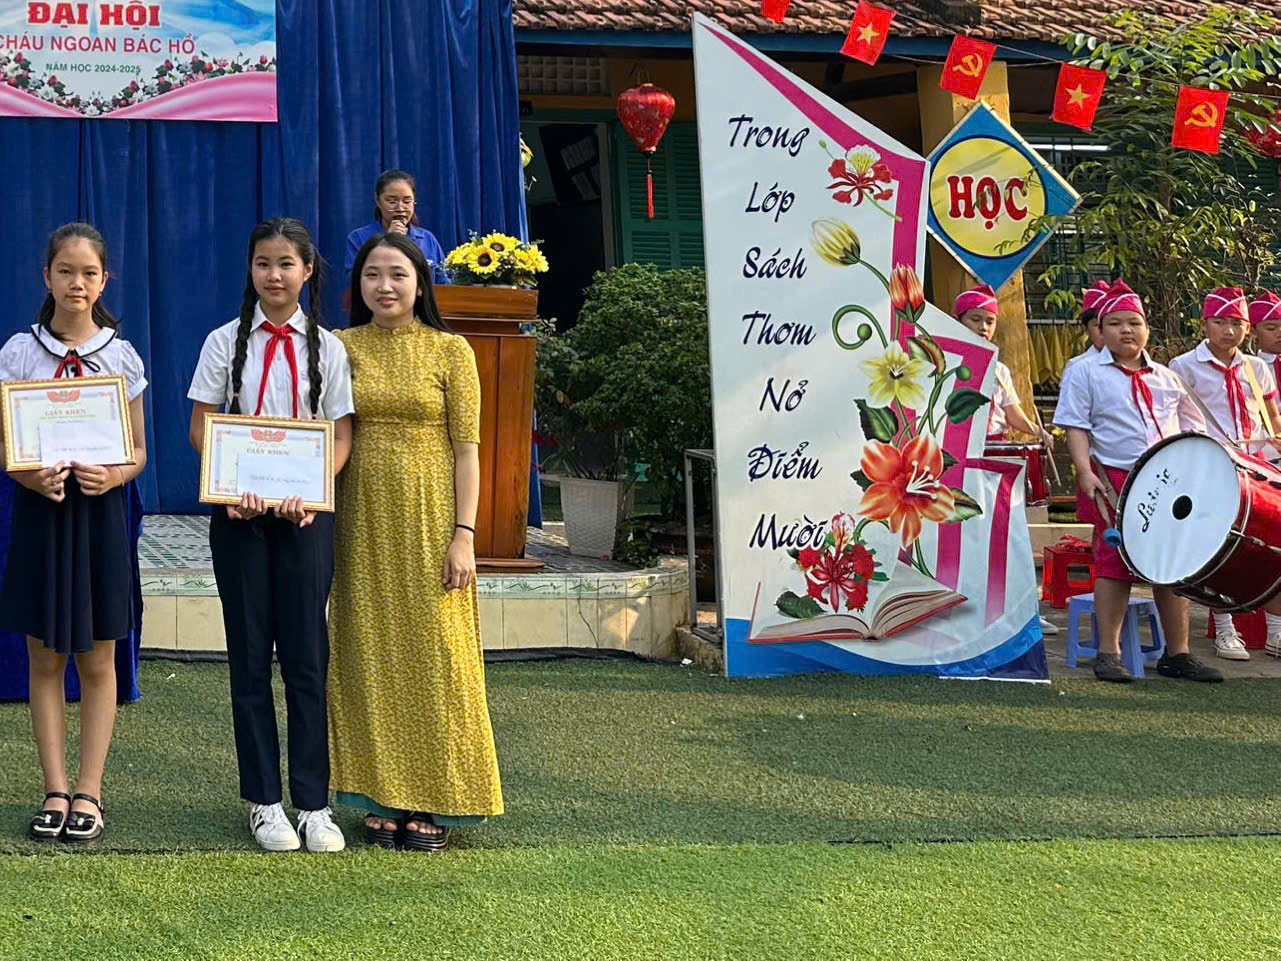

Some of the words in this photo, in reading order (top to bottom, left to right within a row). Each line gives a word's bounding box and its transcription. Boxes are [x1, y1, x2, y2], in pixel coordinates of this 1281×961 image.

[27, 2, 89, 28] ĐẠI
[100, 0, 160, 30] HỘI
[50, 36, 116, 52] NGOAN
[124, 33, 161, 53] BÁC
[169, 32, 195, 54] HỒ
[70, 63, 91, 73] HỌC
[95, 64, 141, 74] 2024-2025
[728, 114, 810, 157] Trong
[745, 181, 795, 223] Lớp
[947, 175, 1029, 230] HỌC
[743, 246, 807, 280] Sách
[741, 311, 817, 346] Thơm
[759, 377, 808, 412] Nở
[748, 441, 823, 481] Điểm
[749, 513, 828, 551] Mười
